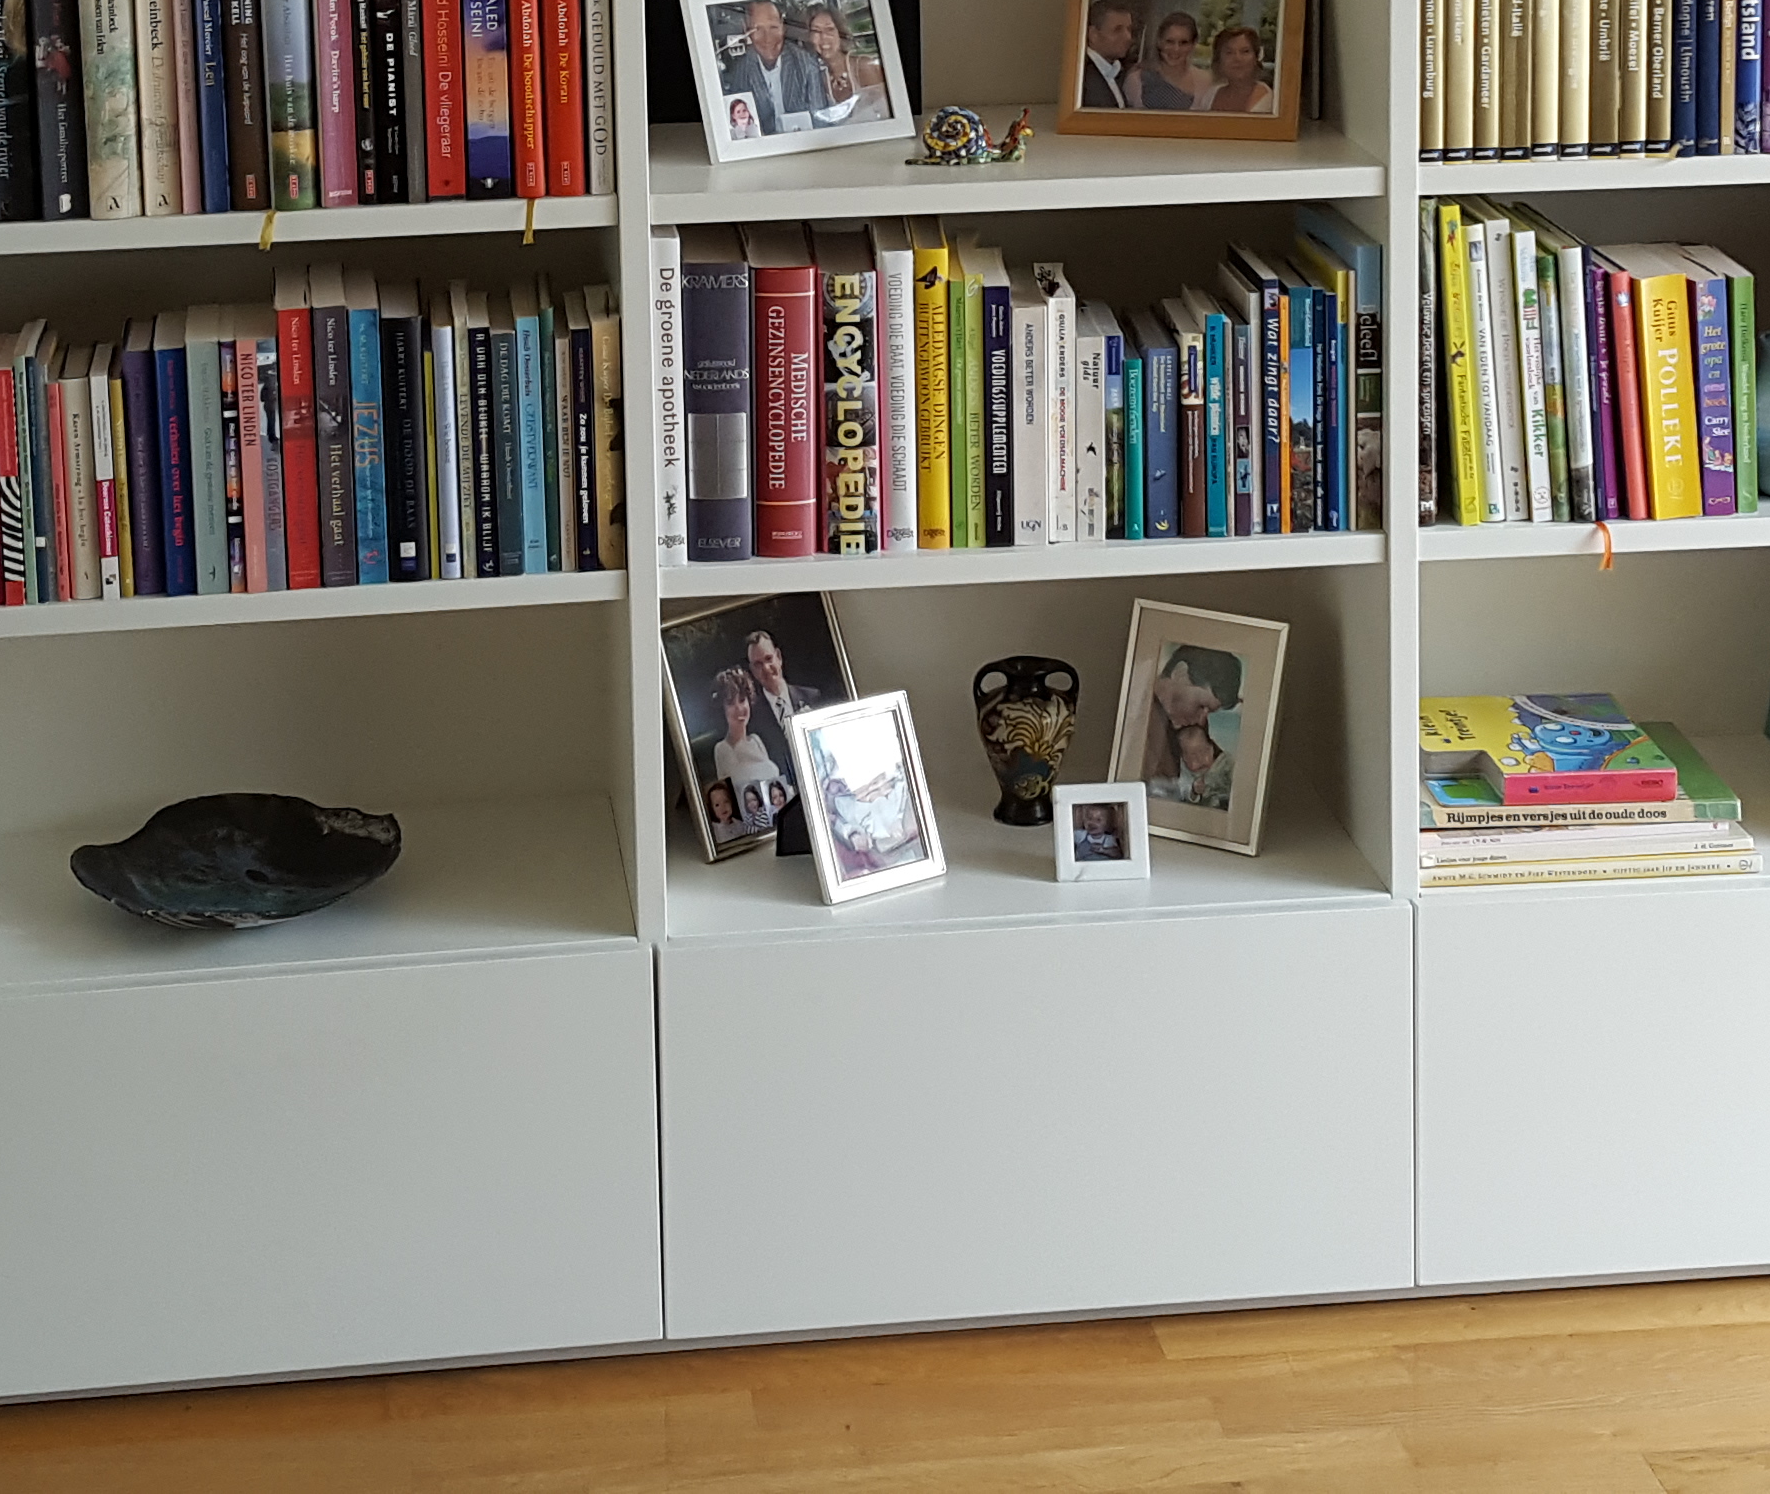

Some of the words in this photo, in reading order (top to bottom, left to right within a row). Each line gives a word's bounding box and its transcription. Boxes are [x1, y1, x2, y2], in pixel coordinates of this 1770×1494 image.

[385, 33, 394, 51] DE
[437, 10, 451, 67] Hosseini
[591, 11, 606, 74] GEDULD
[387, 58, 397, 116] PIANIST
[439, 71, 451, 90] De
[559, 70, 570, 103] Koran
[1651, 47, 1664, 98] Oberland
[594, 81, 606, 111] MET
[436, 94, 453, 158] vliegeraar
[659, 268, 675, 291] De
[888, 274, 903, 319] VOEDING
[656, 299, 674, 367] groene
[890, 324, 903, 341] DIE
[1267, 317, 1280, 346] Wat
[1651, 298, 1664, 342] Kuijer
[240, 353, 252, 379] NICO
[243, 383, 253, 402] TER
[767, 306, 785, 489] GEZINSENCYCLOPEDIE
[790, 353, 808, 442] MEDISCHE
[890, 375, 904, 420] VOEDING
[991, 350, 1008, 473] VOEDINGSSUPPLEMENTEN
[1657, 348, 1682, 467] POLLEKE
[244, 406, 256, 446] LINDEN
[657, 376, 680, 468] apotheek
[834, 274, 865, 557] ENCYCLOPEDIE
[891, 425, 905, 441] DIE
[933, 403, 946, 459] DINGEN
[1267, 398, 1280, 442] daar?
[1532, 409, 1546, 457] Kikker
[330, 444, 342, 468] Het
[892, 446, 907, 491] SCHAADT
[331, 472, 344, 516] verhaal
[329, 520, 345, 546] gaat
[1637, 808, 1666, 820] doos
